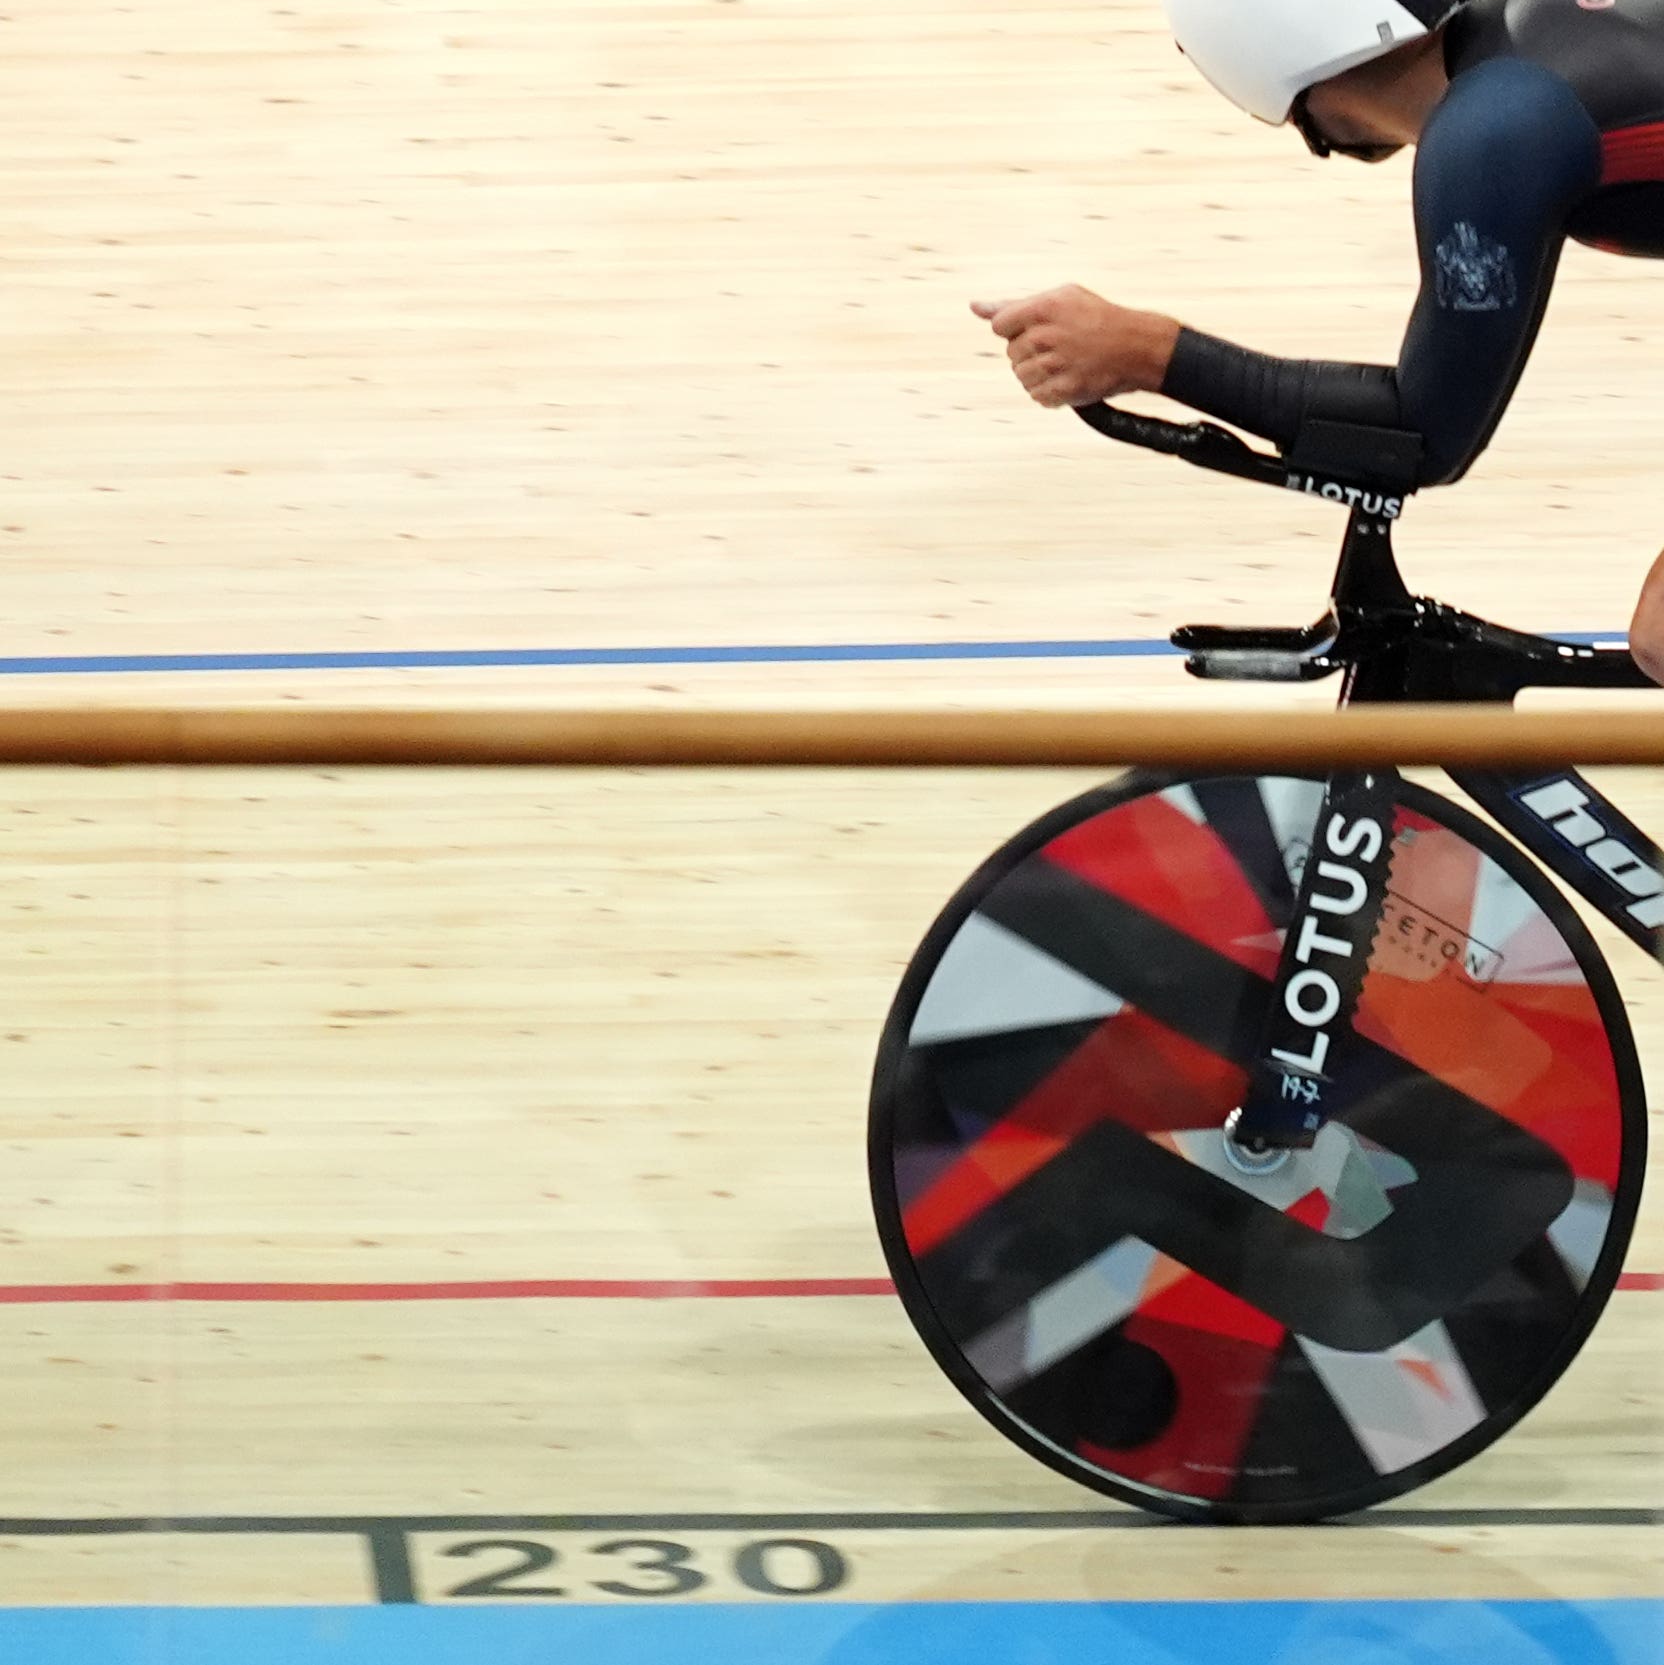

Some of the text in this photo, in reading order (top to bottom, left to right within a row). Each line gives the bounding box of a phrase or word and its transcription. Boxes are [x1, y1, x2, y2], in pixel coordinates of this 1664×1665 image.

[1305, 475, 1401, 519] LOTUS
[1271, 812, 1384, 1074] LOTUS
[436, 1536, 852, 1598] 230
